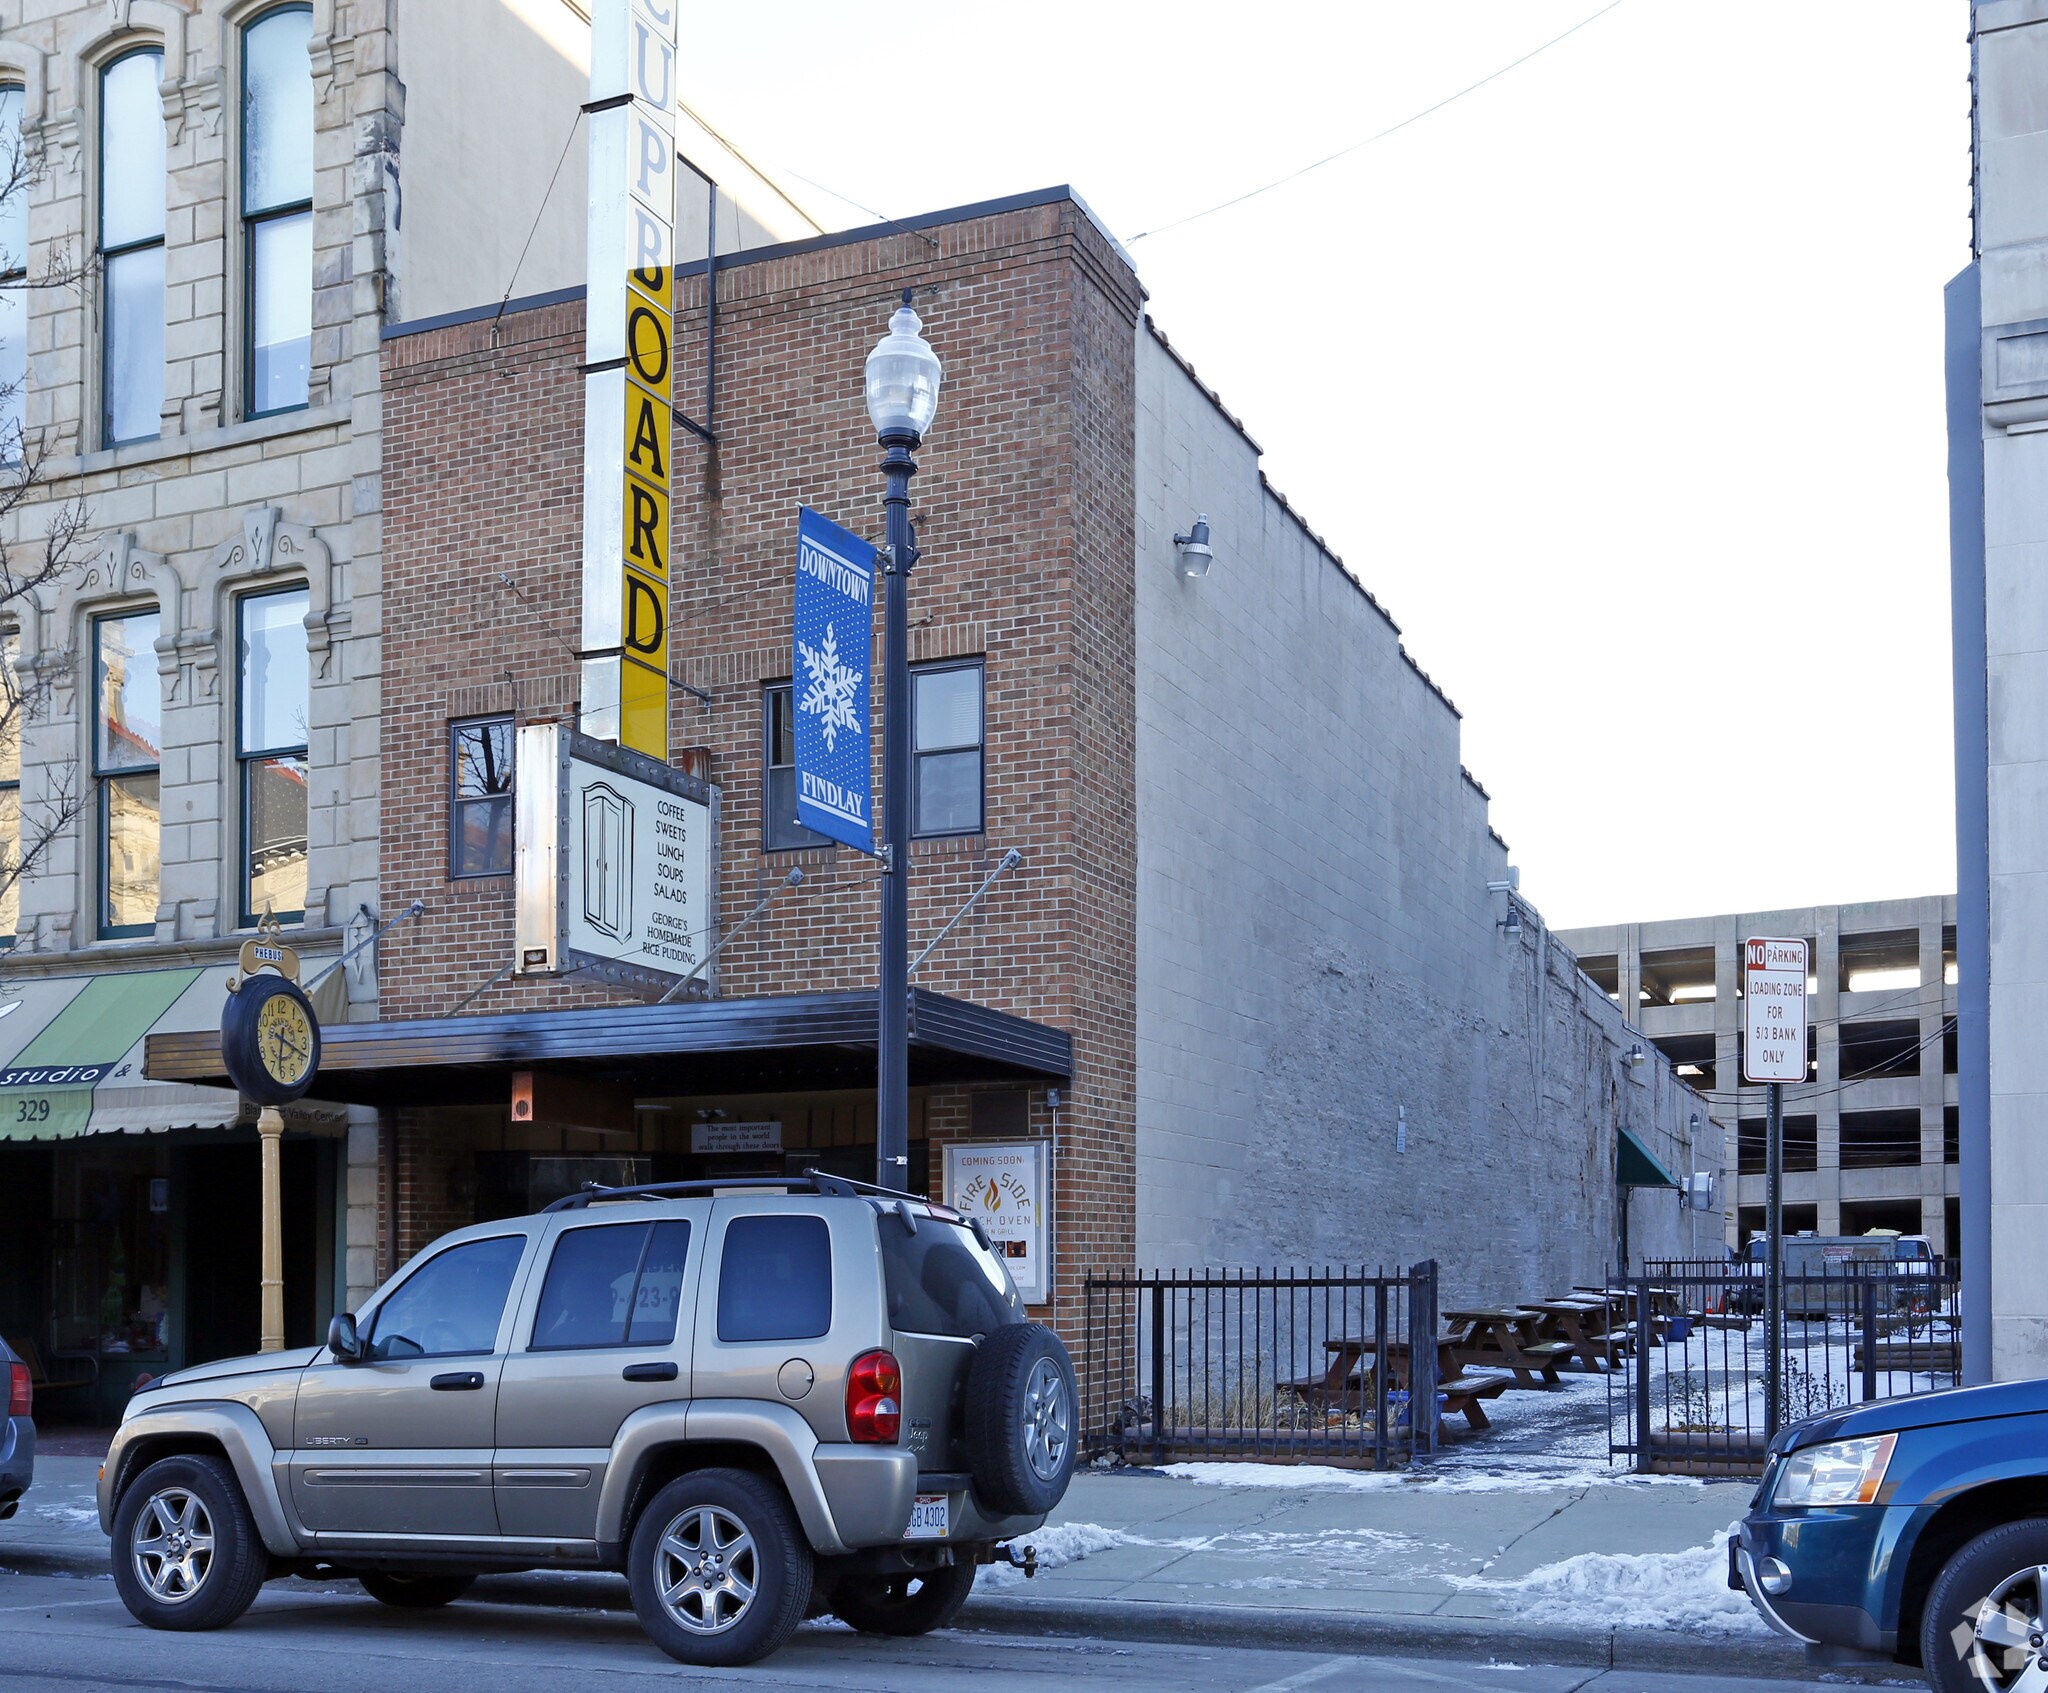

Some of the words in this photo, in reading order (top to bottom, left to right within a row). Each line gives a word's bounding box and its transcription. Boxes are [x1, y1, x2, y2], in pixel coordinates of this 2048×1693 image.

[799, 543, 869, 607] DOWNTOWN
[802, 770, 863, 817] FINDLAY
[657, 800, 685, 822] COFFEE
[655, 820, 687, 843] SWEETS
[657, 842, 684, 863] LUNCH
[657, 863, 684, 883] SOUPS
[654, 882, 687, 905] SALADS
[652, 912, 688, 932] GEORGE'S
[647, 926, 692, 948] HOMEMADE
[642, 942, 660, 957] RICE
[662, 946, 696, 965] PUDDING
[1748, 945, 1765, 965] NO
[1767, 949, 1803, 964] PARKING
[1750, 981, 1781, 996] LOADING
[1783, 983, 1802, 997] ZONE
[267, 1003, 274, 1016] 11
[277, 1000, 286, 1014] 12
[1767, 1006, 1783, 1019] FOR
[297, 1019, 303, 1033] 2
[1756, 1027, 1769, 1040] 5/3
[1773, 1028, 1797, 1041] BANK
[302, 1036, 307, 1050] 3
[1763, 1050, 1785, 1063] ONLY
[0, 1067, 99, 1085] studio
[114, 1063, 132, 1077] &
[270, 1060, 275, 1074] 7
[280, 1065, 285, 1079] 6
[289, 1063, 295, 1076] 5
[17, 1099, 50, 1122] 329
[707, 1133, 727, 1142] people
[739, 1132, 749, 1140] the
[752, 1131, 770, 1139] world
[739, 1124, 770, 1133] important
[715, 1142, 740, 1152] through
[742, 1141, 759, 1149] these
[962, 1157, 995, 1166] COMING
[959, 1174, 987, 1211] FIRE
[1000, 1172, 1031, 1210] SIDE
[999, 1215, 1031, 1226] OVEN
[305, 1437, 350, 1445] LIBERTY
[908, 1427, 928, 1443] Jeep
[924, 1506, 945, 1527] 4302
